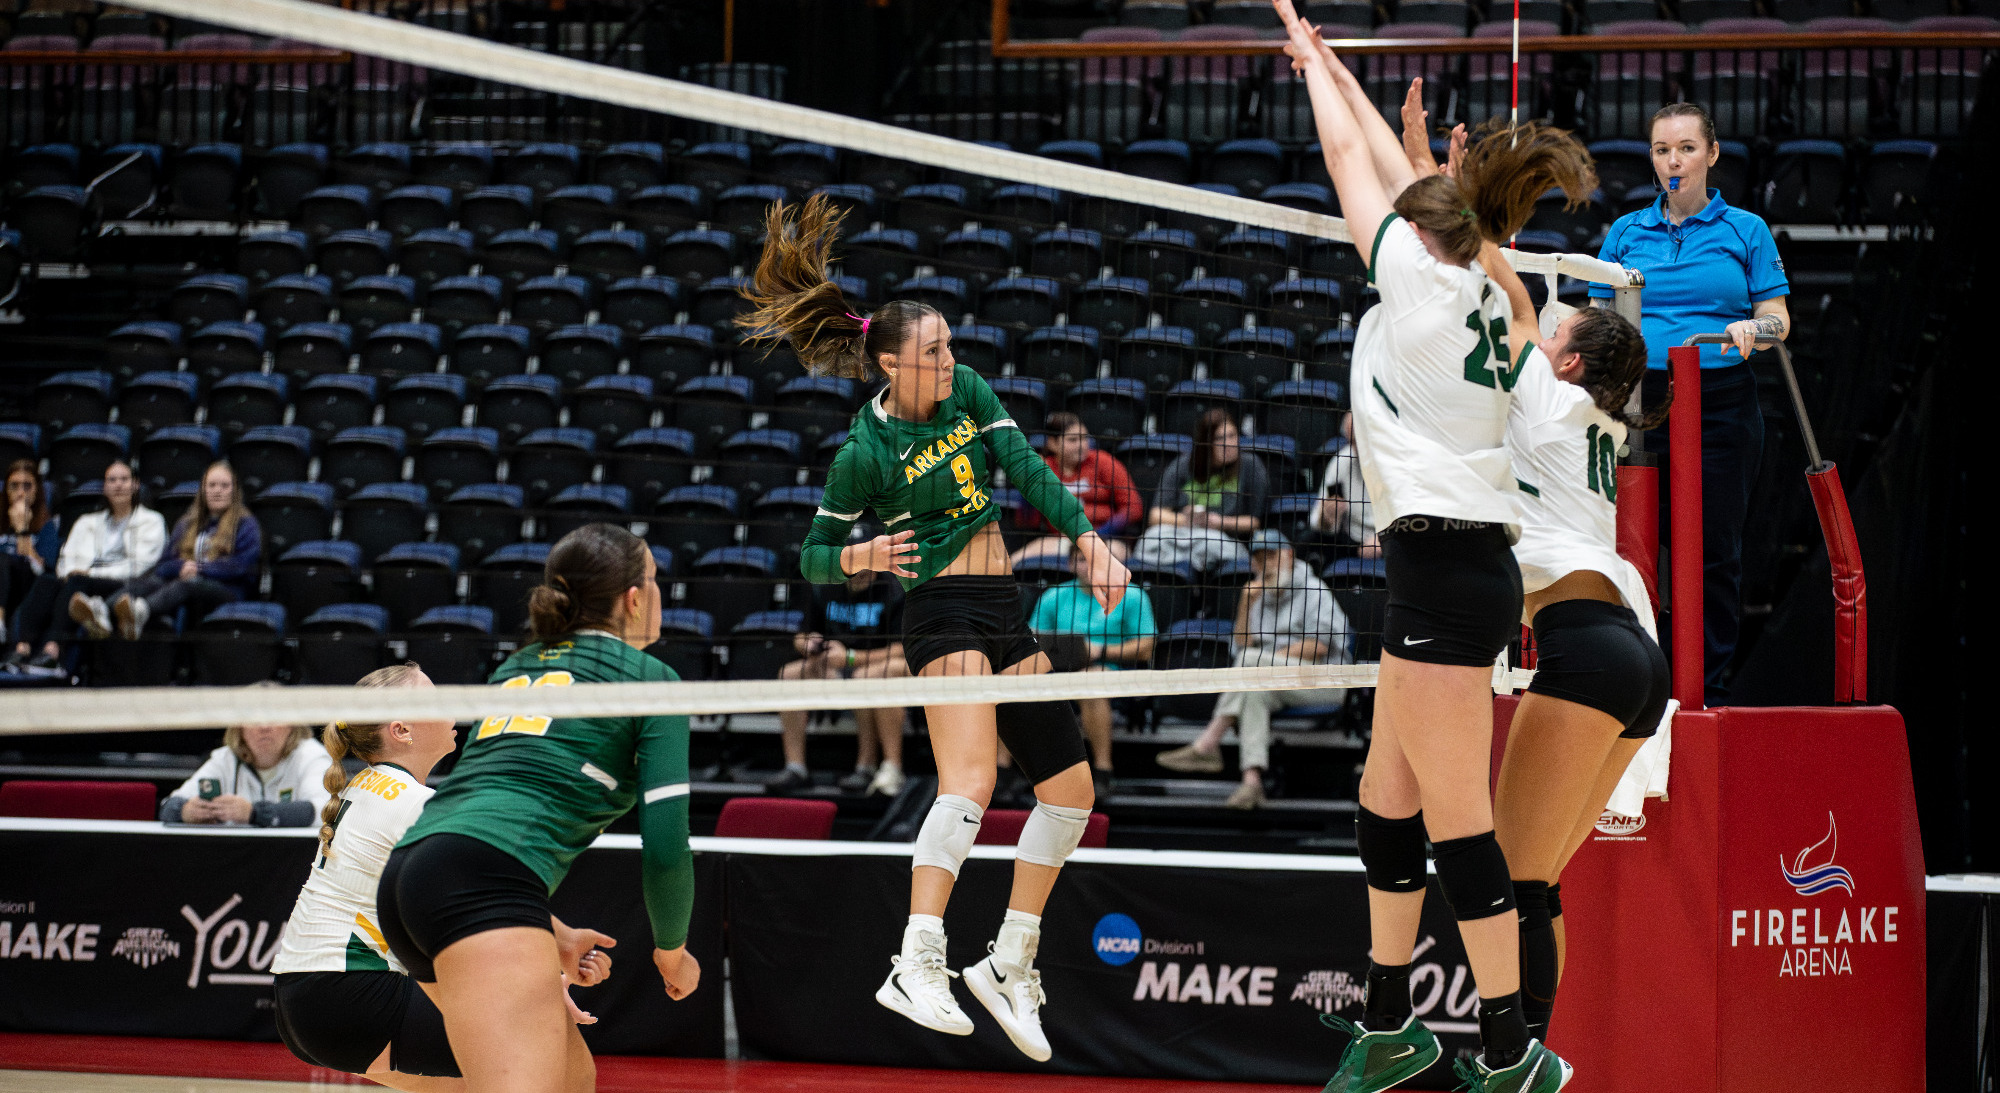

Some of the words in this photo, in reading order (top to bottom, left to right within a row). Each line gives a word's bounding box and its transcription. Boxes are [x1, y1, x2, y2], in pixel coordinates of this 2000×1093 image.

[1464, 309, 1513, 393] 25
[951, 453, 976, 499] 9
[1587, 423, 1617, 505] 10
[1596, 815, 1642, 826] SNH
[127, 928, 165, 939] GREAT
[1731, 906, 1899, 947] FIRELAKE
[111, 938, 181, 959] AMERICAN
[1097, 936, 1141, 954] NCAA
[1144, 938, 1195, 955] Division
[1196, 940, 1205, 955] II
[1779, 947, 1853, 978] ARENA
[1132, 961, 1278, 1006] MAKE
[1307, 970, 1350, 984] GREAT
